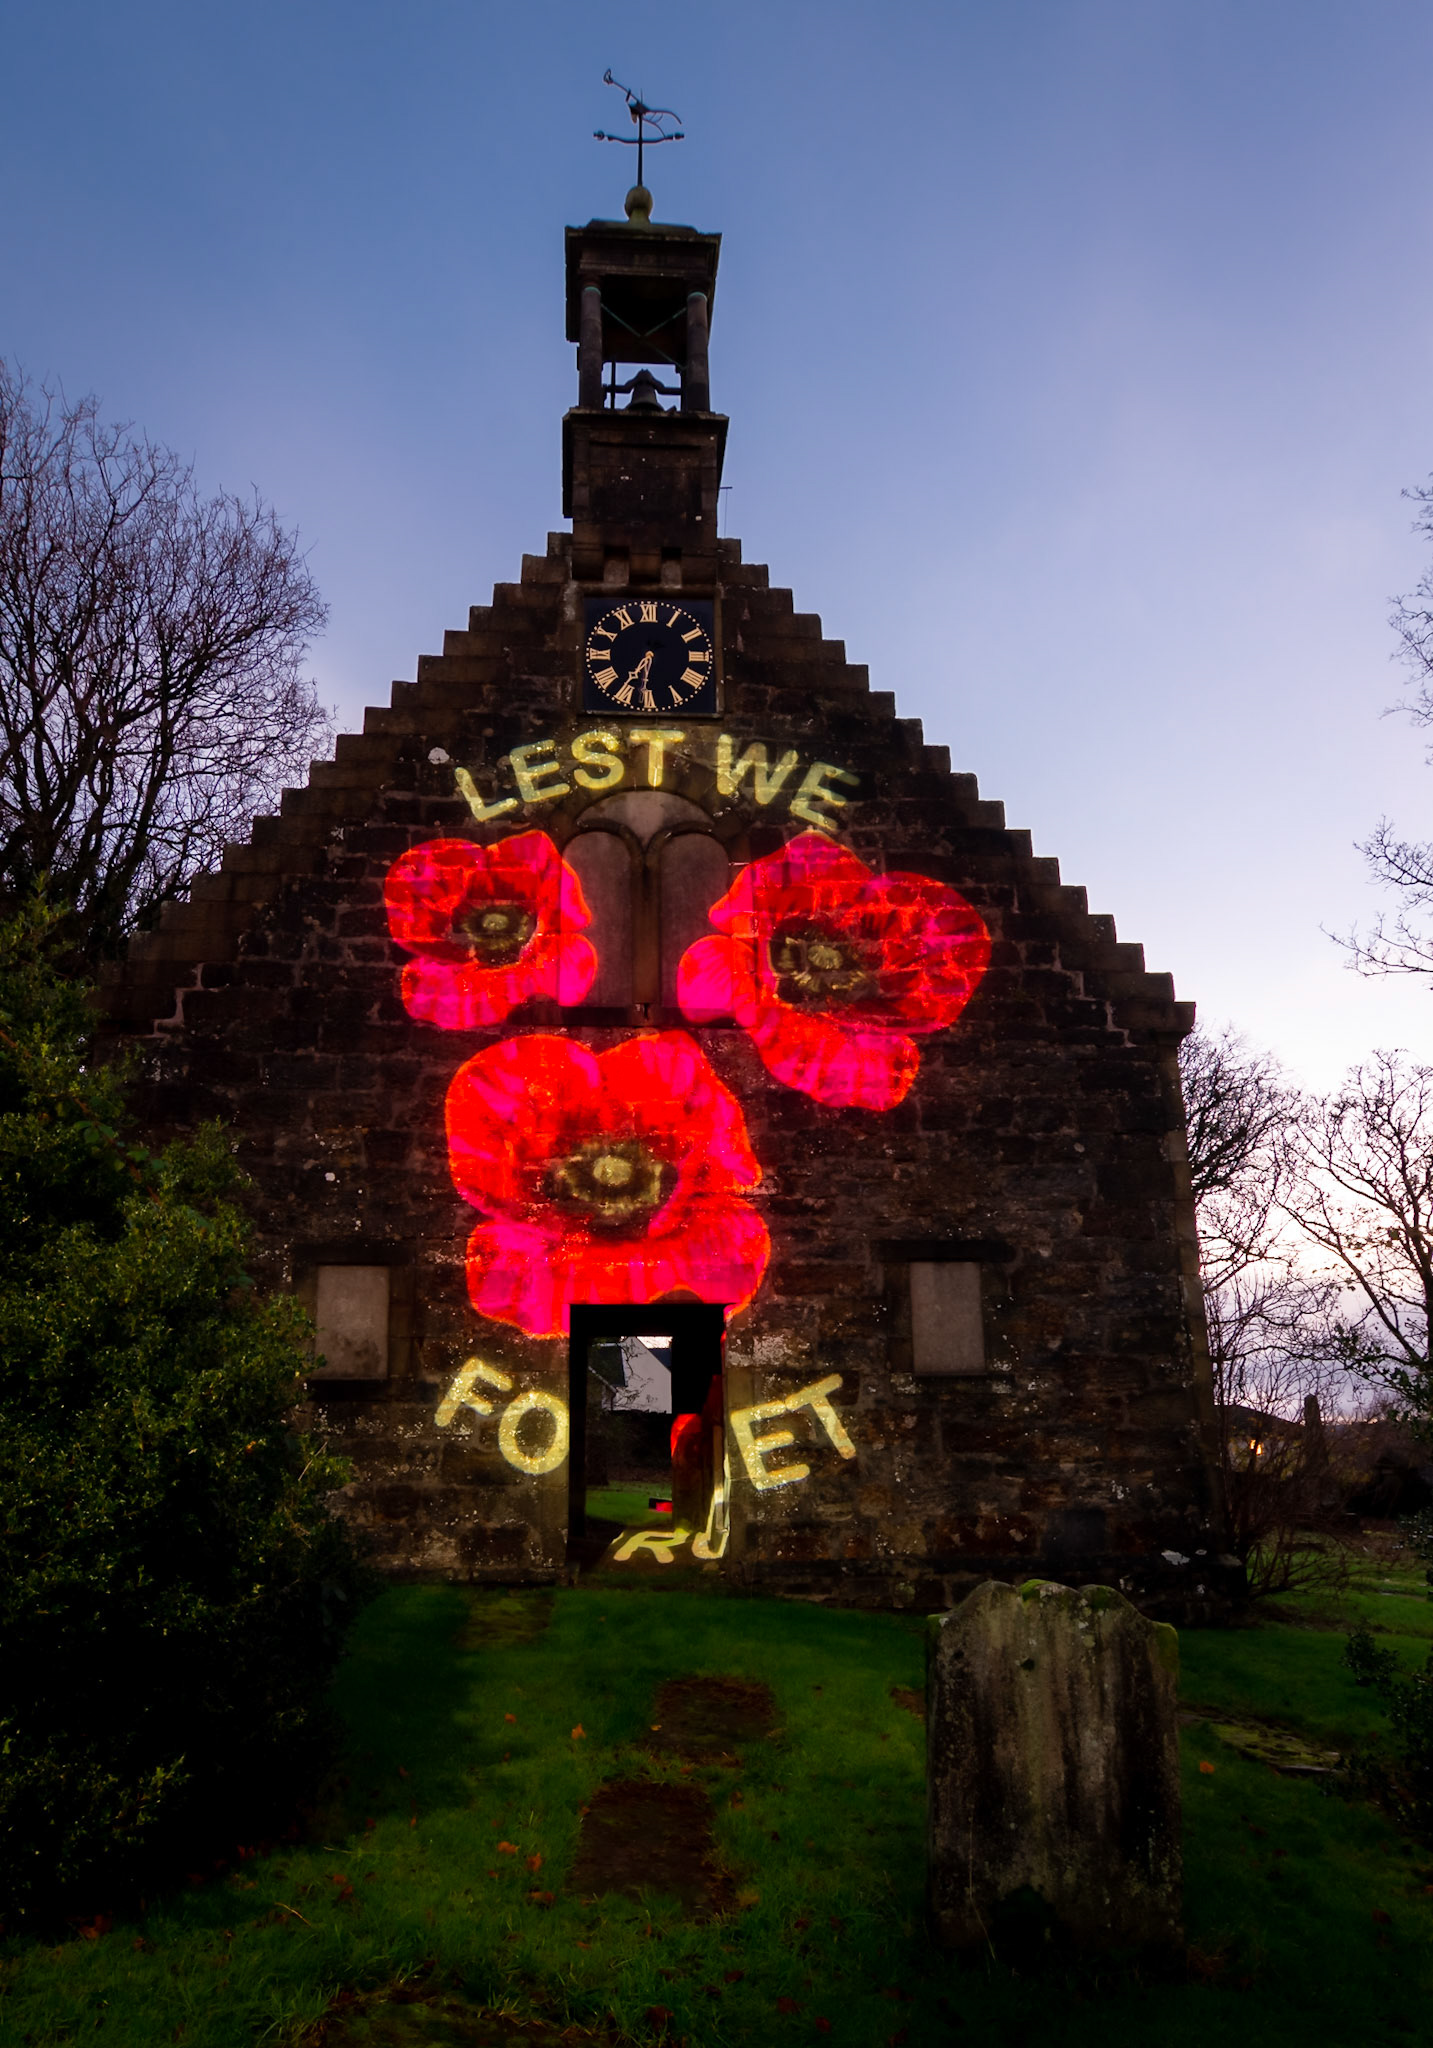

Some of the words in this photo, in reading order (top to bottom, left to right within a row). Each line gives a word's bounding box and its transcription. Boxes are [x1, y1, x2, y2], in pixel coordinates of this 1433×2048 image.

[613, 609, 635, 630] XI
[640, 603, 658, 622] XII
[666, 610, 681, 628] I
[596, 626, 618, 642] X
[681, 627, 702, 643] II
[589, 648, 611, 660] IX
[688, 650, 709, 662] III
[594, 666, 619, 689] VIII
[680, 667, 705, 689] IIII
[614, 684, 635, 705] VII
[668, 685, 683, 704] V
[454, 729, 686, 822] LEST
[716, 733, 861, 831] WE
